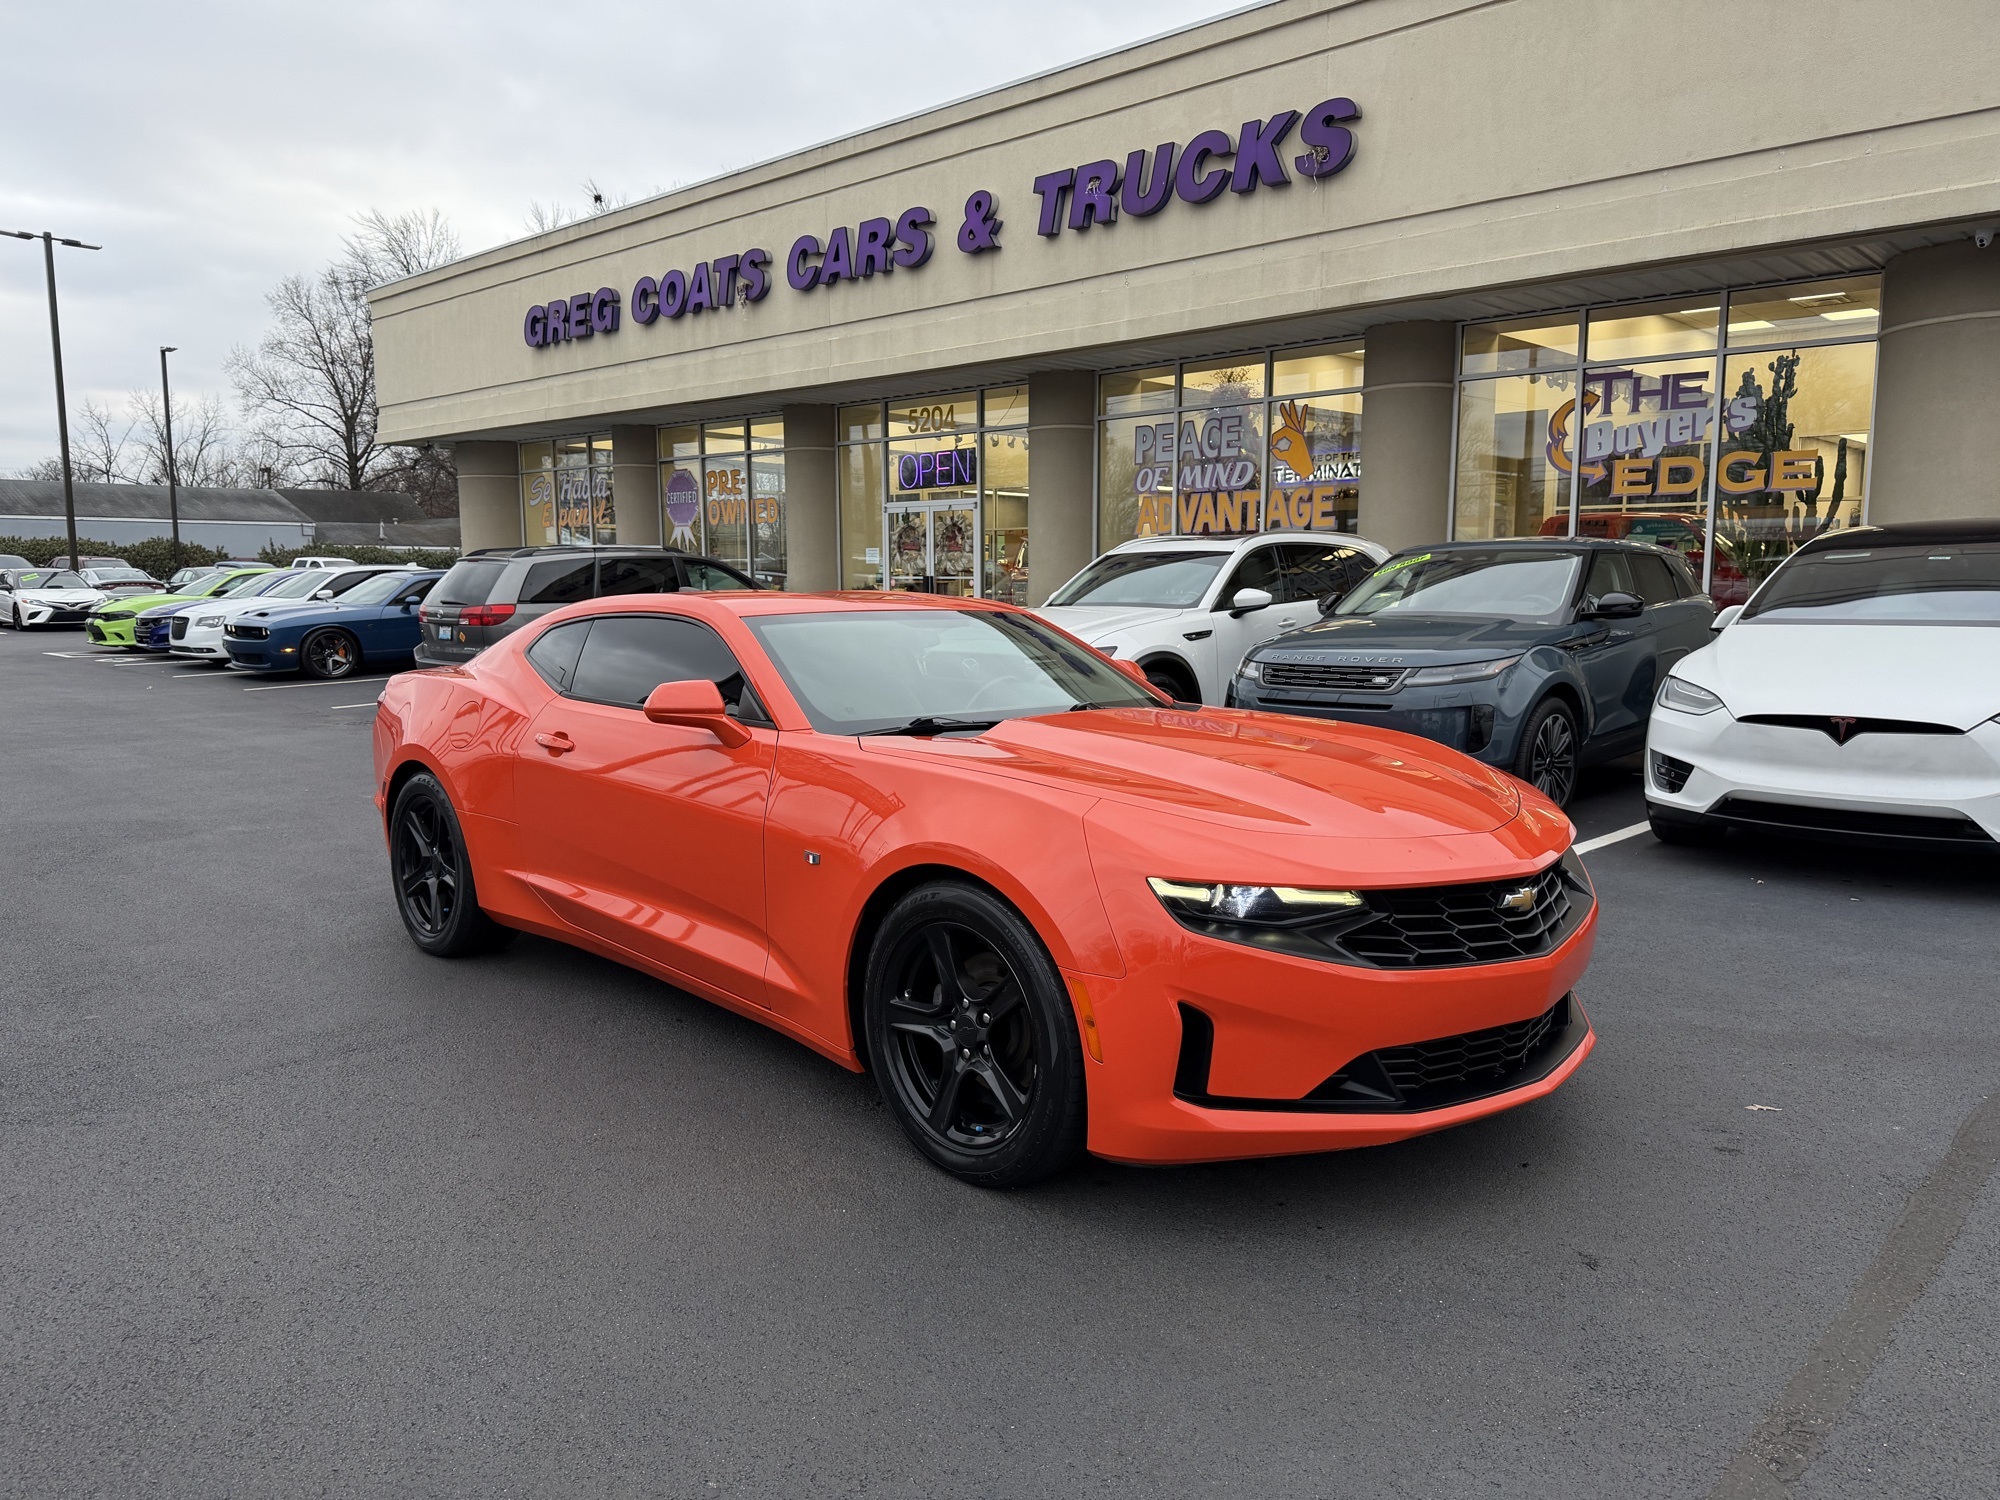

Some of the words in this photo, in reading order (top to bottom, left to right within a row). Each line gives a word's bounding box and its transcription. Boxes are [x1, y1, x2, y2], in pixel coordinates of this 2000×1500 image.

[524, 287, 620, 348] GREG
[631, 248, 772, 325] COATS
[787, 206, 936, 291] CARS
[957, 190, 1003, 254] &
[1033, 97, 1362, 238] TRUCKS
[1585, 369, 1710, 416] THE
[908, 405, 955, 433] 5204
[1586, 396, 1758, 462] Buyer's
[1135, 415, 1243, 465] PEACE
[1325, 453, 1338, 461] OF
[1341, 452, 1360, 460] THE
[706, 469, 746, 497] PRE-
[899, 450, 970, 488] OPEN
[1135, 467, 1169, 493] OF
[1179, 460, 1257, 492] MIND
[1609, 448, 1818, 498] EDGE
[529, 475, 551, 507] Se
[560, 470, 610, 501] Habla
[666, 491, 697, 504] CERTIFIED
[708, 497, 778, 526] OWNED
[1135, 486, 1337, 536] ADVANTAGE
[1271, 654, 1327, 662] RANGE
[1337, 655, 1404, 663] ROVER
